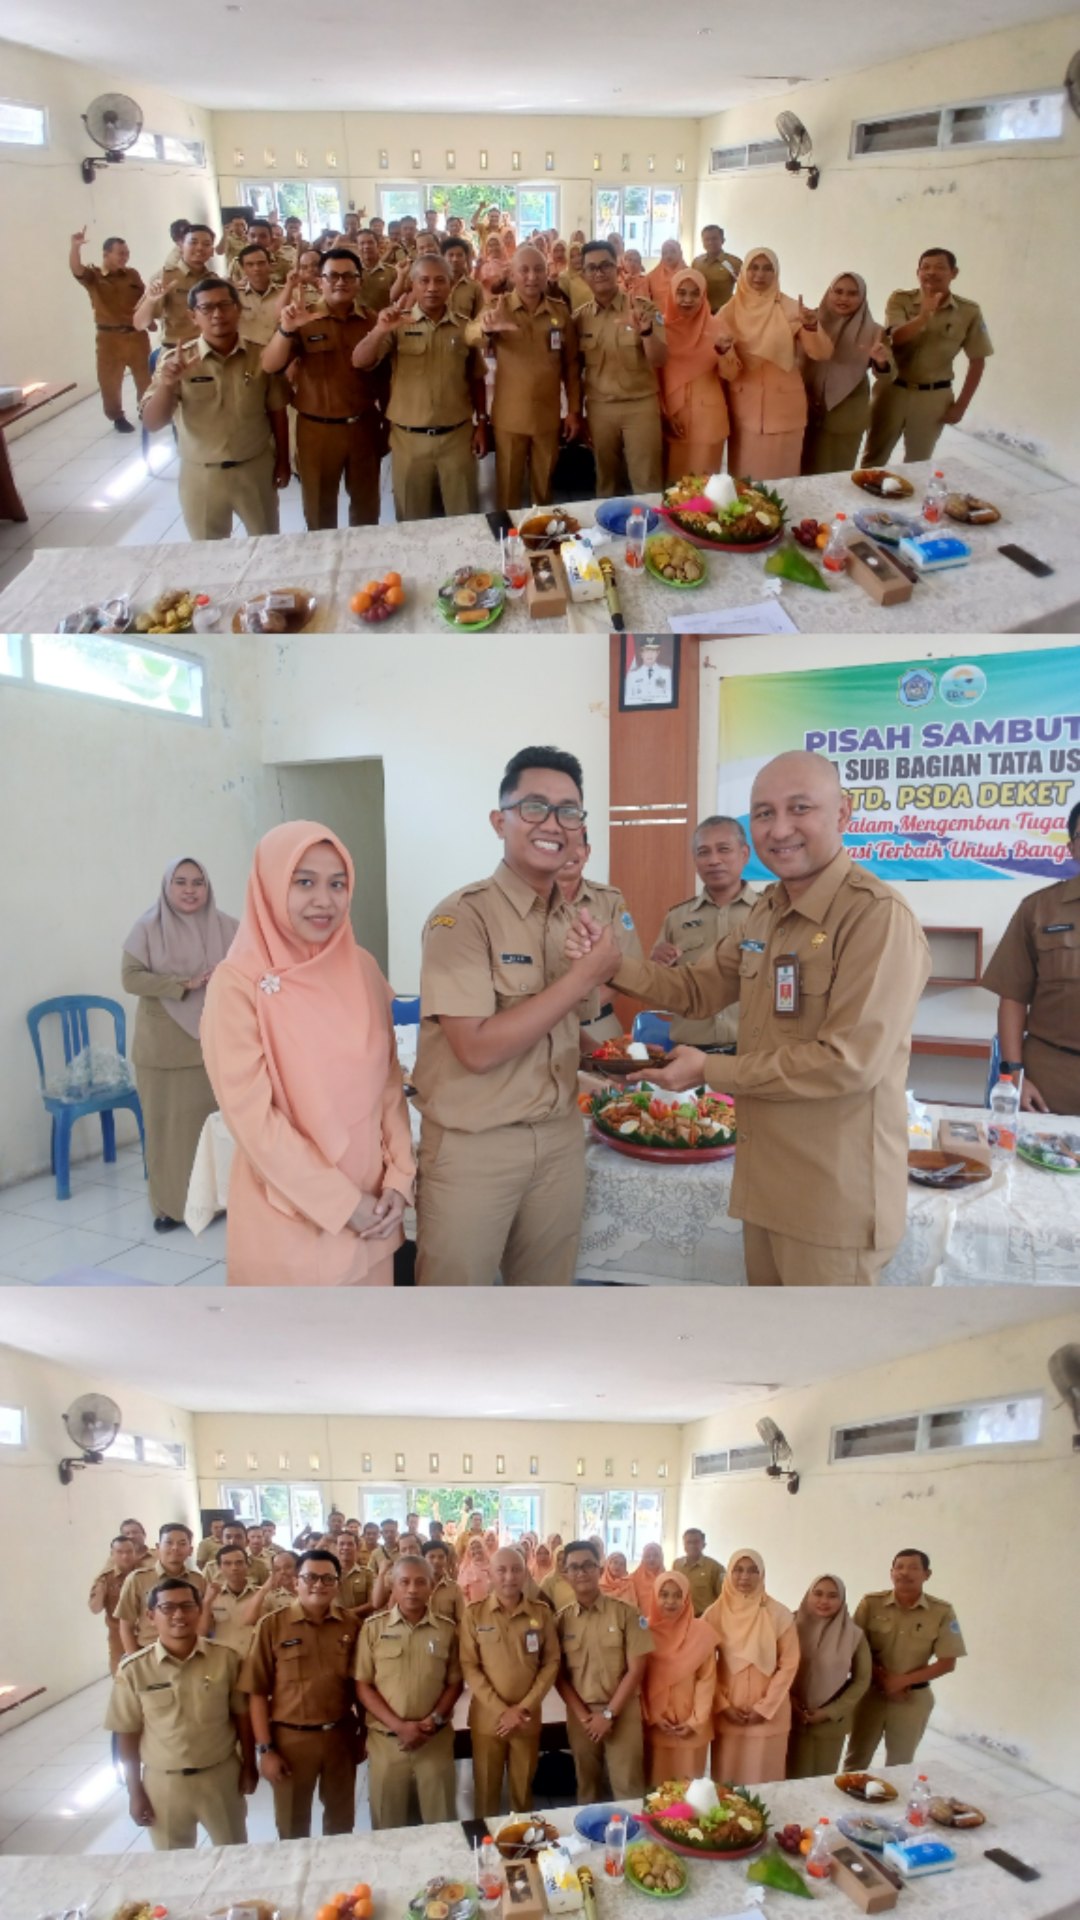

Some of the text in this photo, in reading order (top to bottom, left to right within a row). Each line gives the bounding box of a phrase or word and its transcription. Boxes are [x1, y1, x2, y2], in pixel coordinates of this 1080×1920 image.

[805, 715, 1080, 753] PISAH SAMBUT
[845, 757, 889, 781] SUB
[896, 753, 981, 779] BAGIAN
[988, 750, 1043, 775] TATA
[841, 780, 1074, 811] TD. PSDA DEKET
[847, 811, 1069, 837] alam Mengemban Tuga
[847, 843, 872, 859] asi
[875, 841, 943, 860] Terbaik
[948, 840, 1007, 858] Untuk
